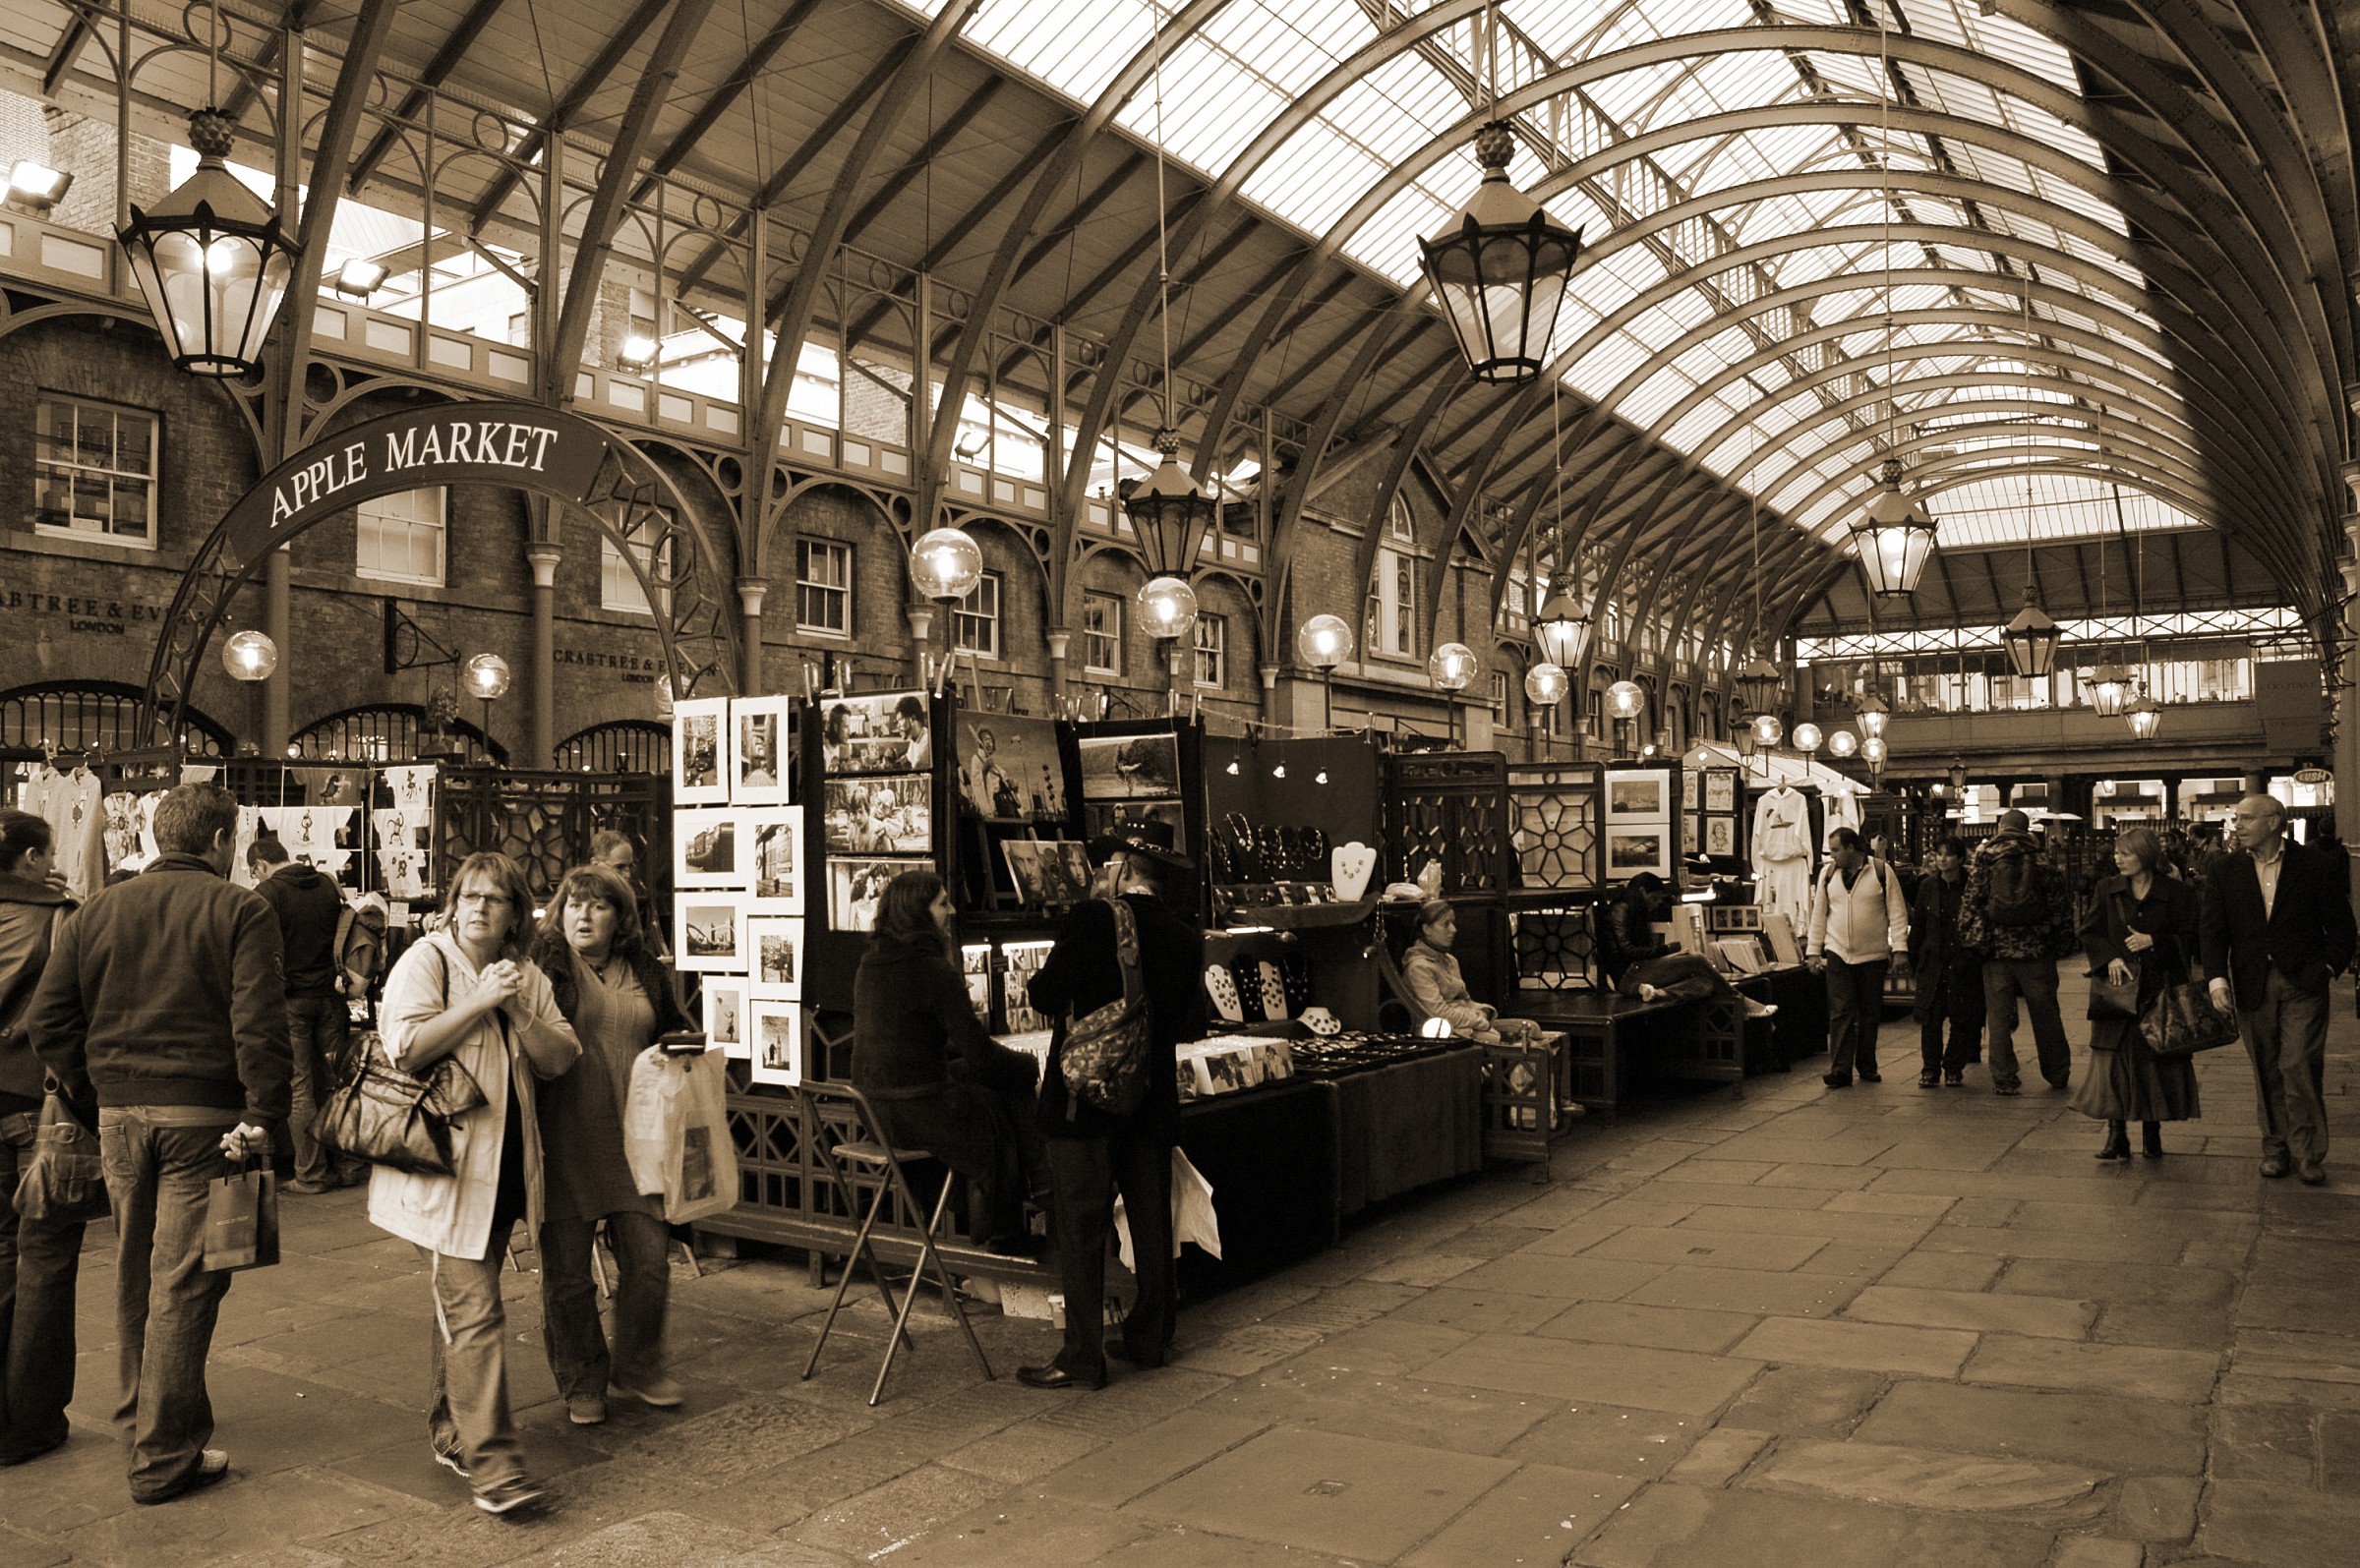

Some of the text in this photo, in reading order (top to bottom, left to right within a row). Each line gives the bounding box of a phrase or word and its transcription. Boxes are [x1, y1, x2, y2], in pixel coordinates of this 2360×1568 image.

[270, 422, 559, 528] APPLE MARKET
[107, 602, 123, 618] &
[70, 618, 125, 635] LONDON
[553, 649, 639, 670] CRABTREE
[643, 659, 653, 671] &
[621, 672, 655, 684] LONDON
[2298, 771, 2327, 783] LUSH
